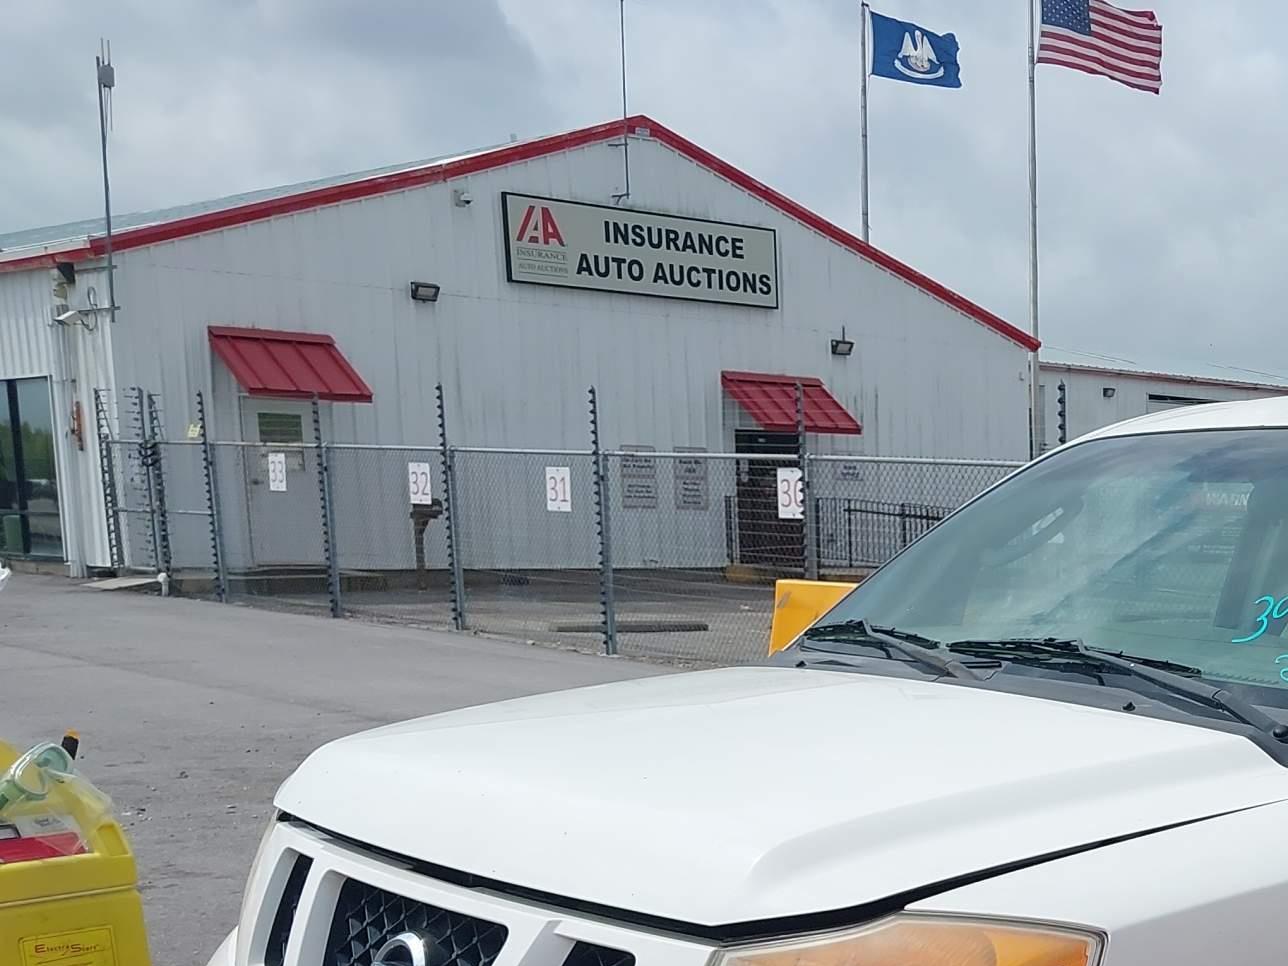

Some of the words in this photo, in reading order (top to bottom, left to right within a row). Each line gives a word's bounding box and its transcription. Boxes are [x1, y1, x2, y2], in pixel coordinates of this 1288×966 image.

[603, 220, 746, 260] INSURANCE
[575, 253, 645, 282] AUTO
[652, 262, 772, 296] AUCTIONS
[270, 460, 285, 484] 33
[410, 477, 431, 497] 32
[549, 475, 570, 503] 31
